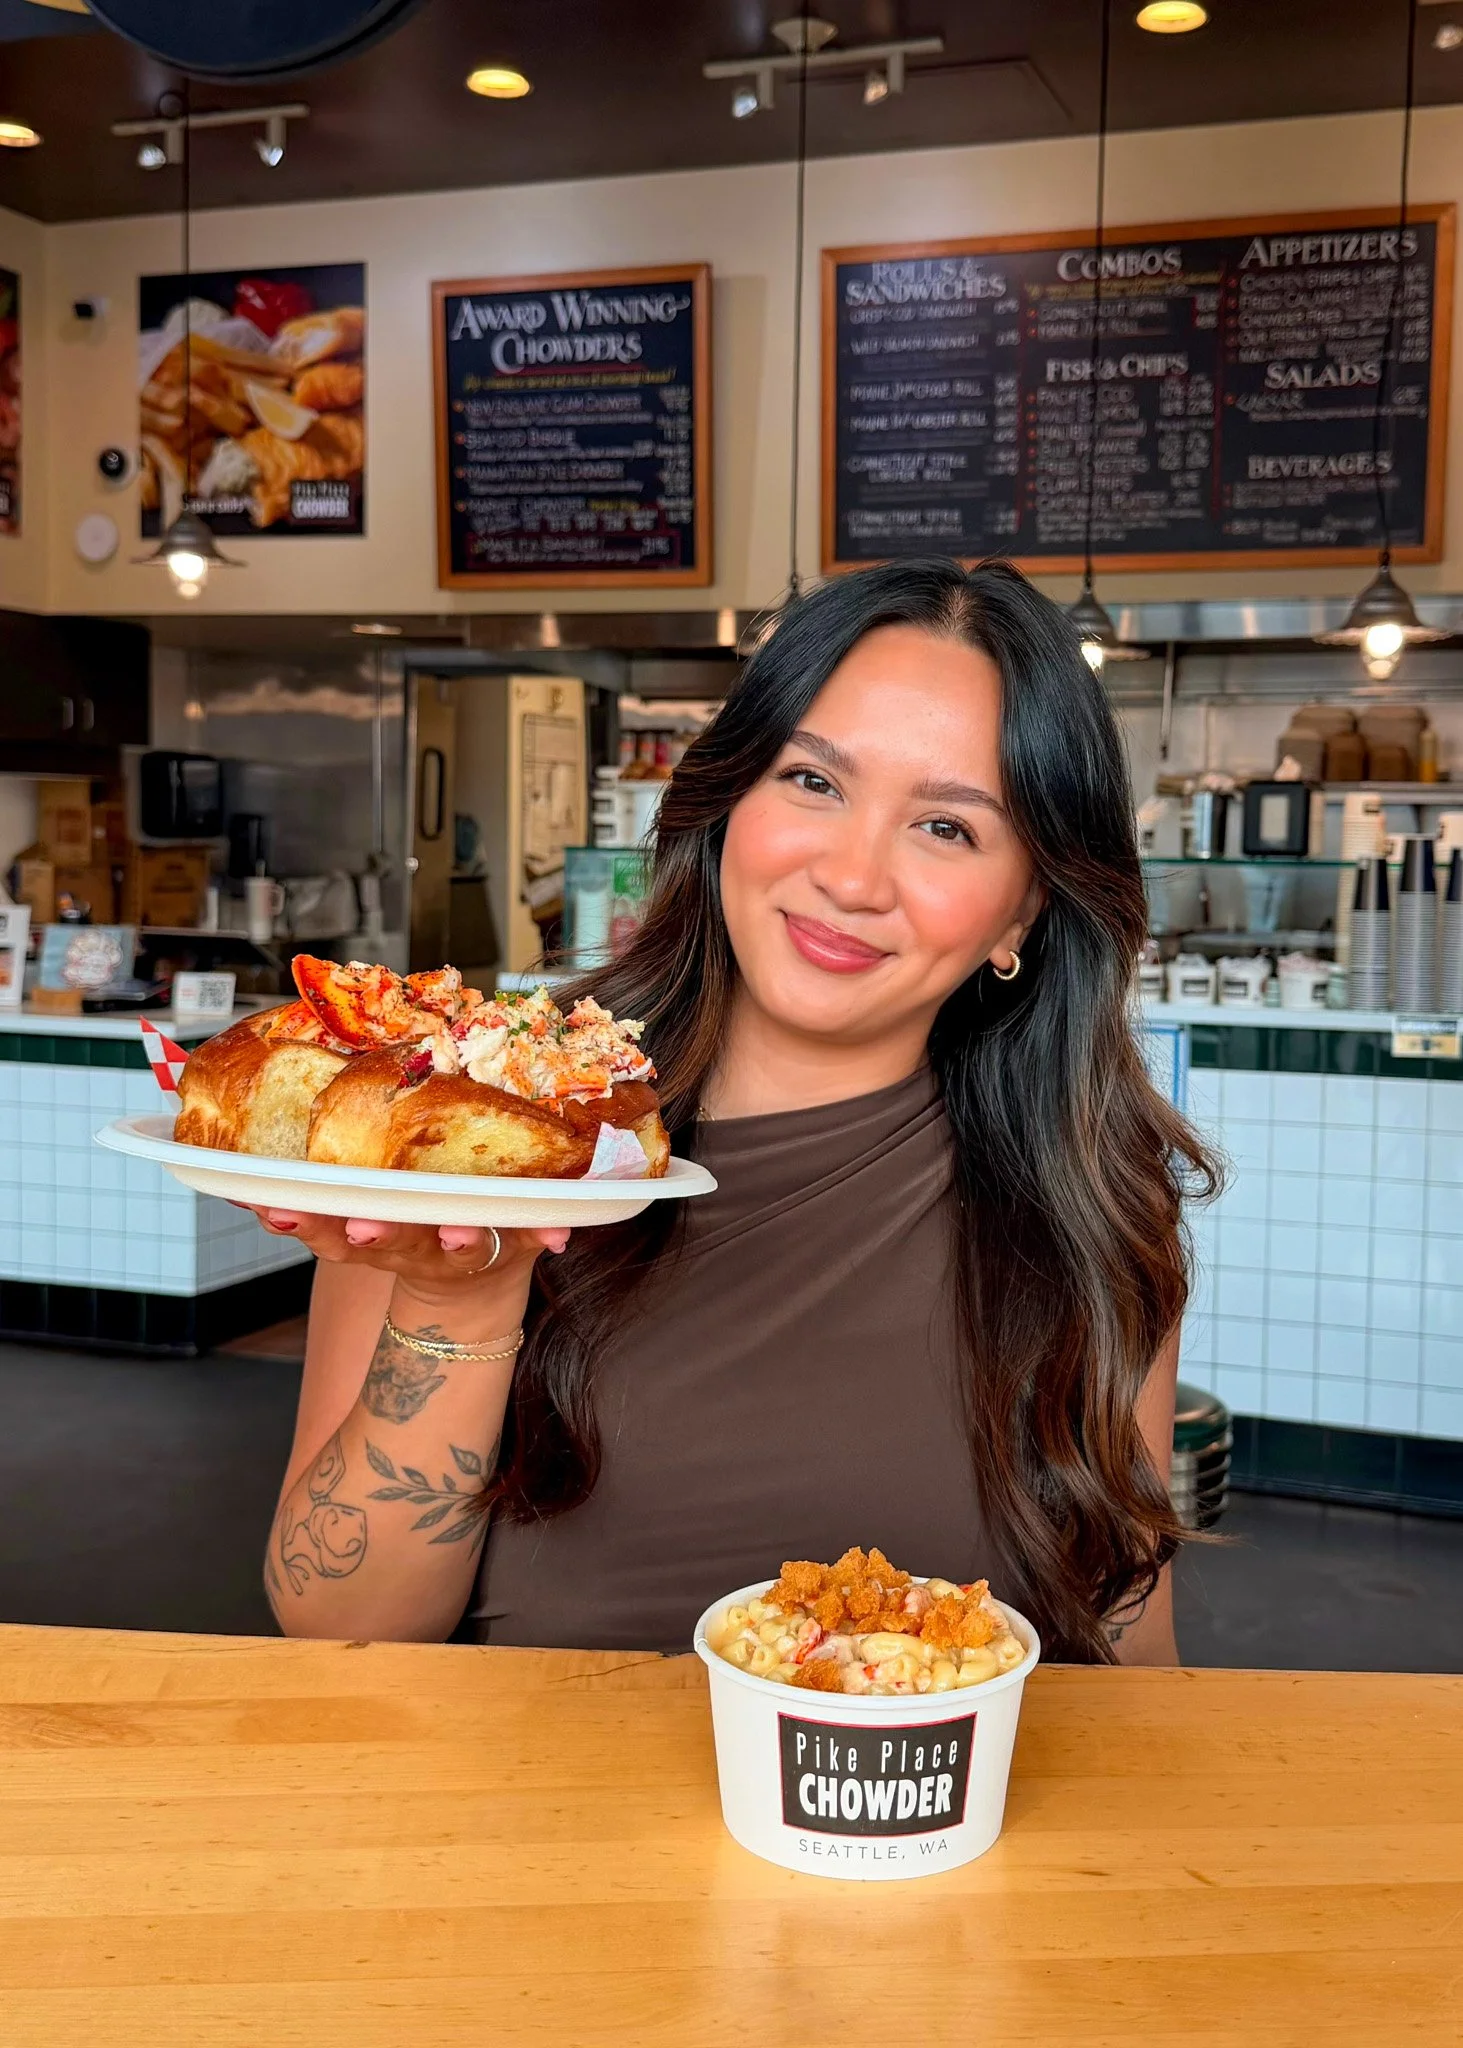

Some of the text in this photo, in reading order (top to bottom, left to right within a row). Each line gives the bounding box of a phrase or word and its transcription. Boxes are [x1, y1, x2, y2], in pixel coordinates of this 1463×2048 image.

[1056, 247, 1183, 281] COMBOS
[1239, 228, 1419, 269] APPETIZERS
[845, 273, 1007, 306] SANDWICHES
[451, 291, 690, 341] AWARD WINNING
[490, 331, 643, 374] CHOWDERS
[1119, 352, 1189, 378] CHIPS
[1264, 361, 1382, 389] SALADS
[1248, 450, 1394, 479] BEVERAGES
[796, 1732, 958, 1774] Pike Place
[798, 1772, 953, 1821] CHOWDER
[799, 1838, 949, 1860] SEATTLE, WA
